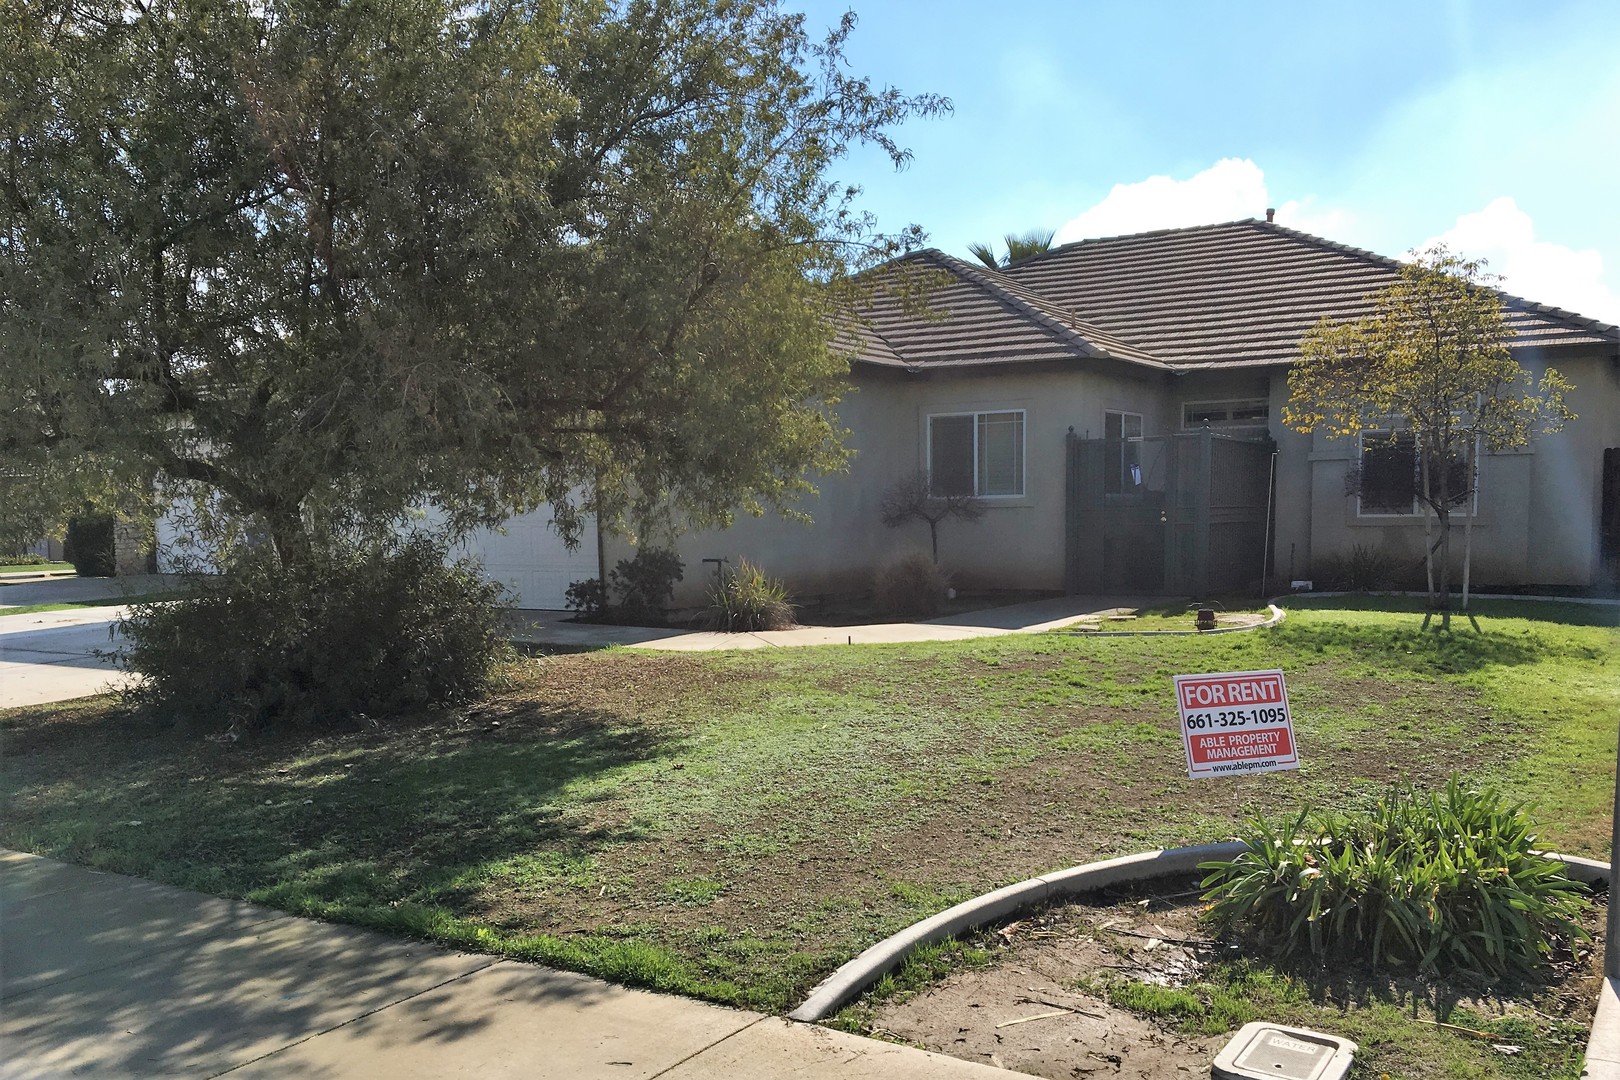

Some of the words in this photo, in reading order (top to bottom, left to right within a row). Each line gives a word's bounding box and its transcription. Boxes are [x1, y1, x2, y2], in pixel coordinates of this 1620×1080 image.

[1184, 684, 1226, 705] FOR
[1228, 681, 1277, 702] RENT
[1187, 707, 1286, 729] 661-325-1095
[1199, 736, 1225, 748] ABLE
[1229, 732, 1280, 745] PROPERTY
[1207, 743, 1277, 759] MANAGEMENT
[1212, 760, 1277, 772] www.ablepm.com
[1272, 1038, 1316, 1052] WATER
